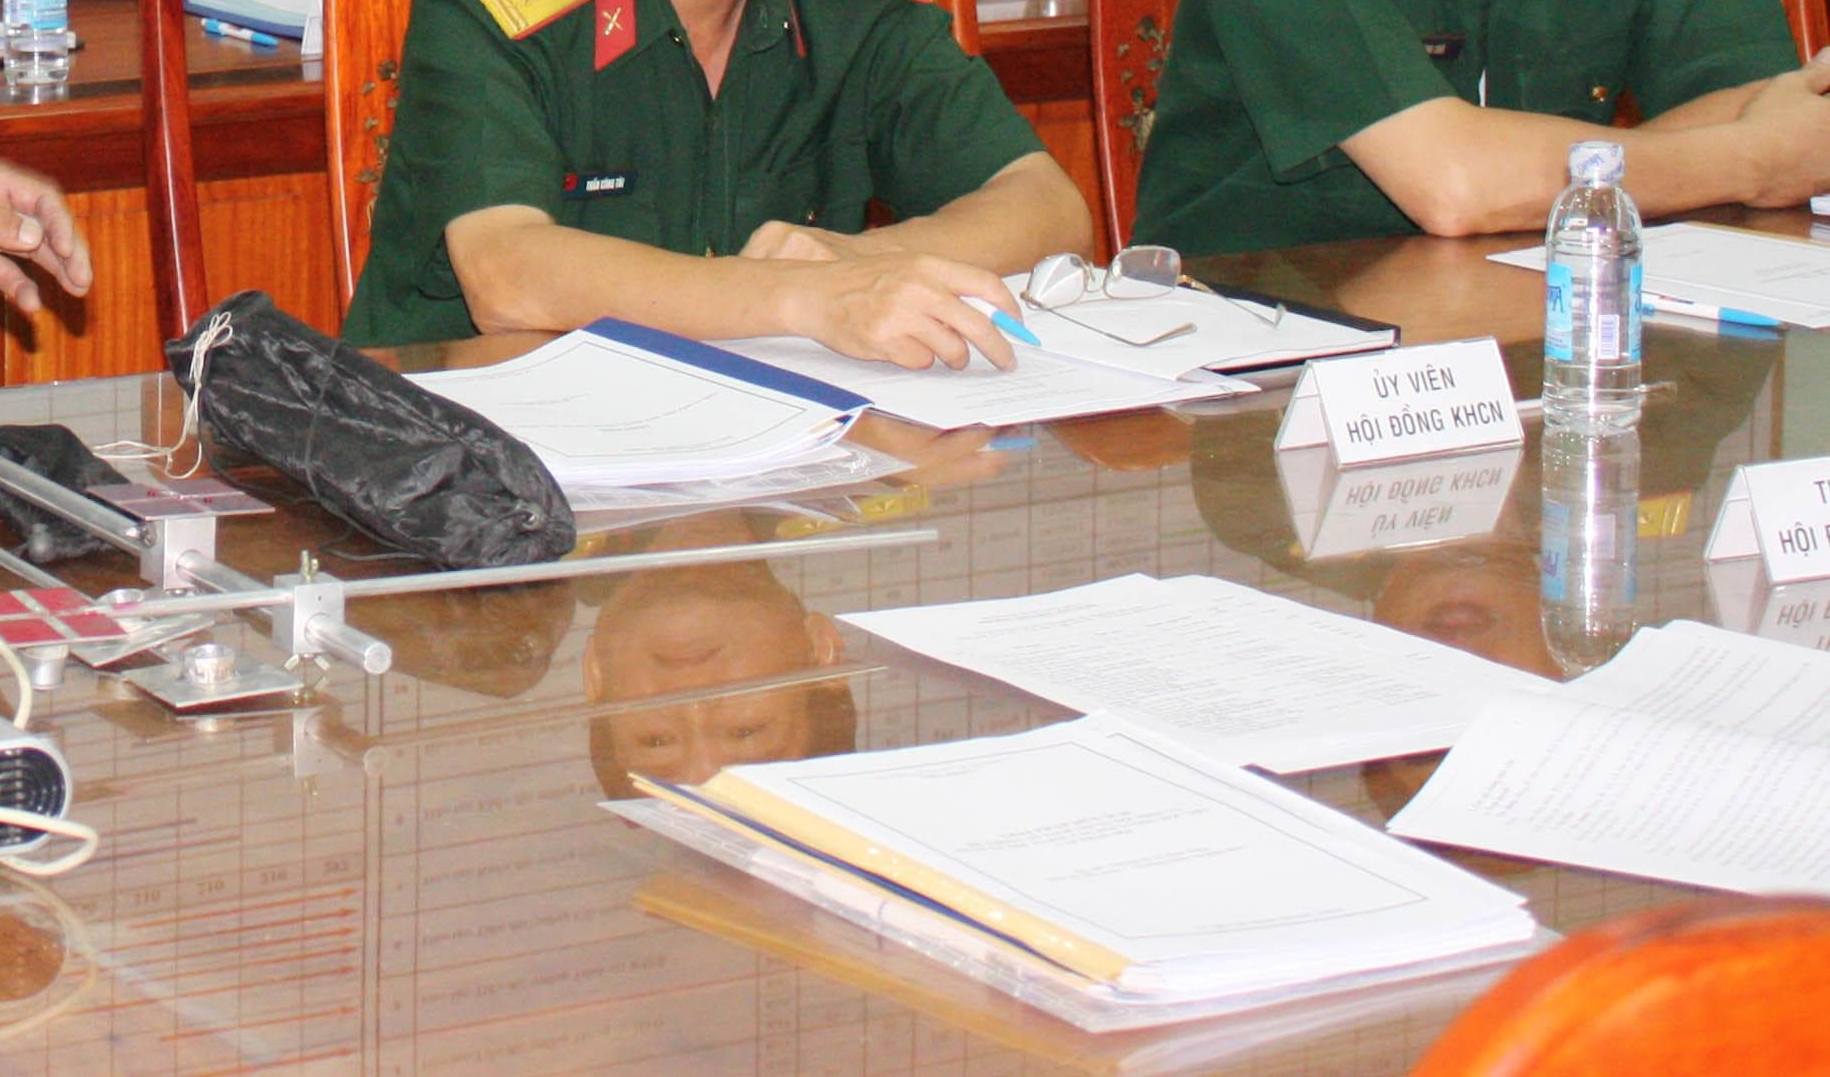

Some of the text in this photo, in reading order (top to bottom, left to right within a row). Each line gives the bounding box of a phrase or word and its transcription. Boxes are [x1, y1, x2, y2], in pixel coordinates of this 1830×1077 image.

[1373, 365, 1457, 399] ỦY VIÊN
[1346, 399, 1505, 447] HỘI ĐỒNG KHCN
[1779, 520, 1819, 558] HỘI
